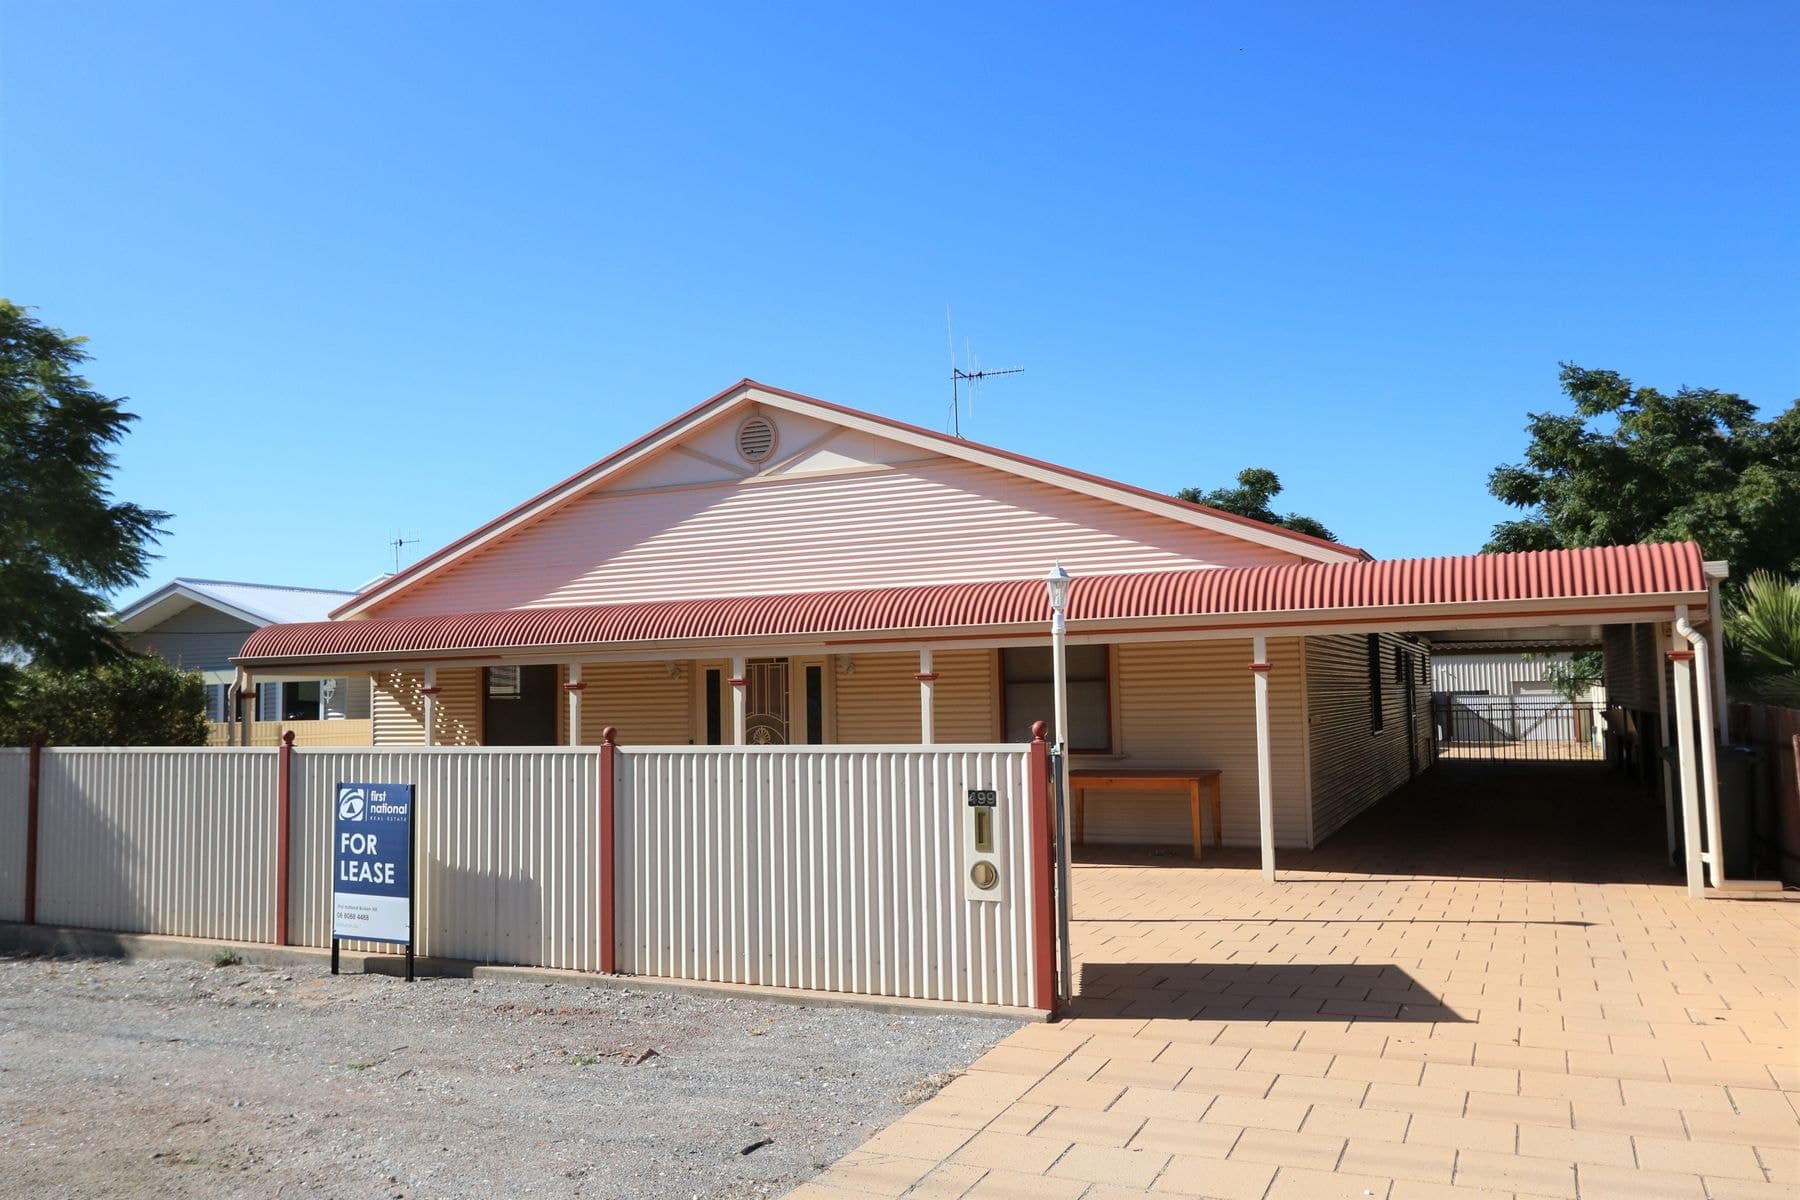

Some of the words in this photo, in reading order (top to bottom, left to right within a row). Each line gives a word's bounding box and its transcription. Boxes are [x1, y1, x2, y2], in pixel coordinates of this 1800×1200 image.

[371, 790, 386, 802] first
[969, 791, 995, 805] 499
[370, 803, 408, 815] national
[341, 832, 378, 855] FOR
[340, 860, 395, 884] LEASE
